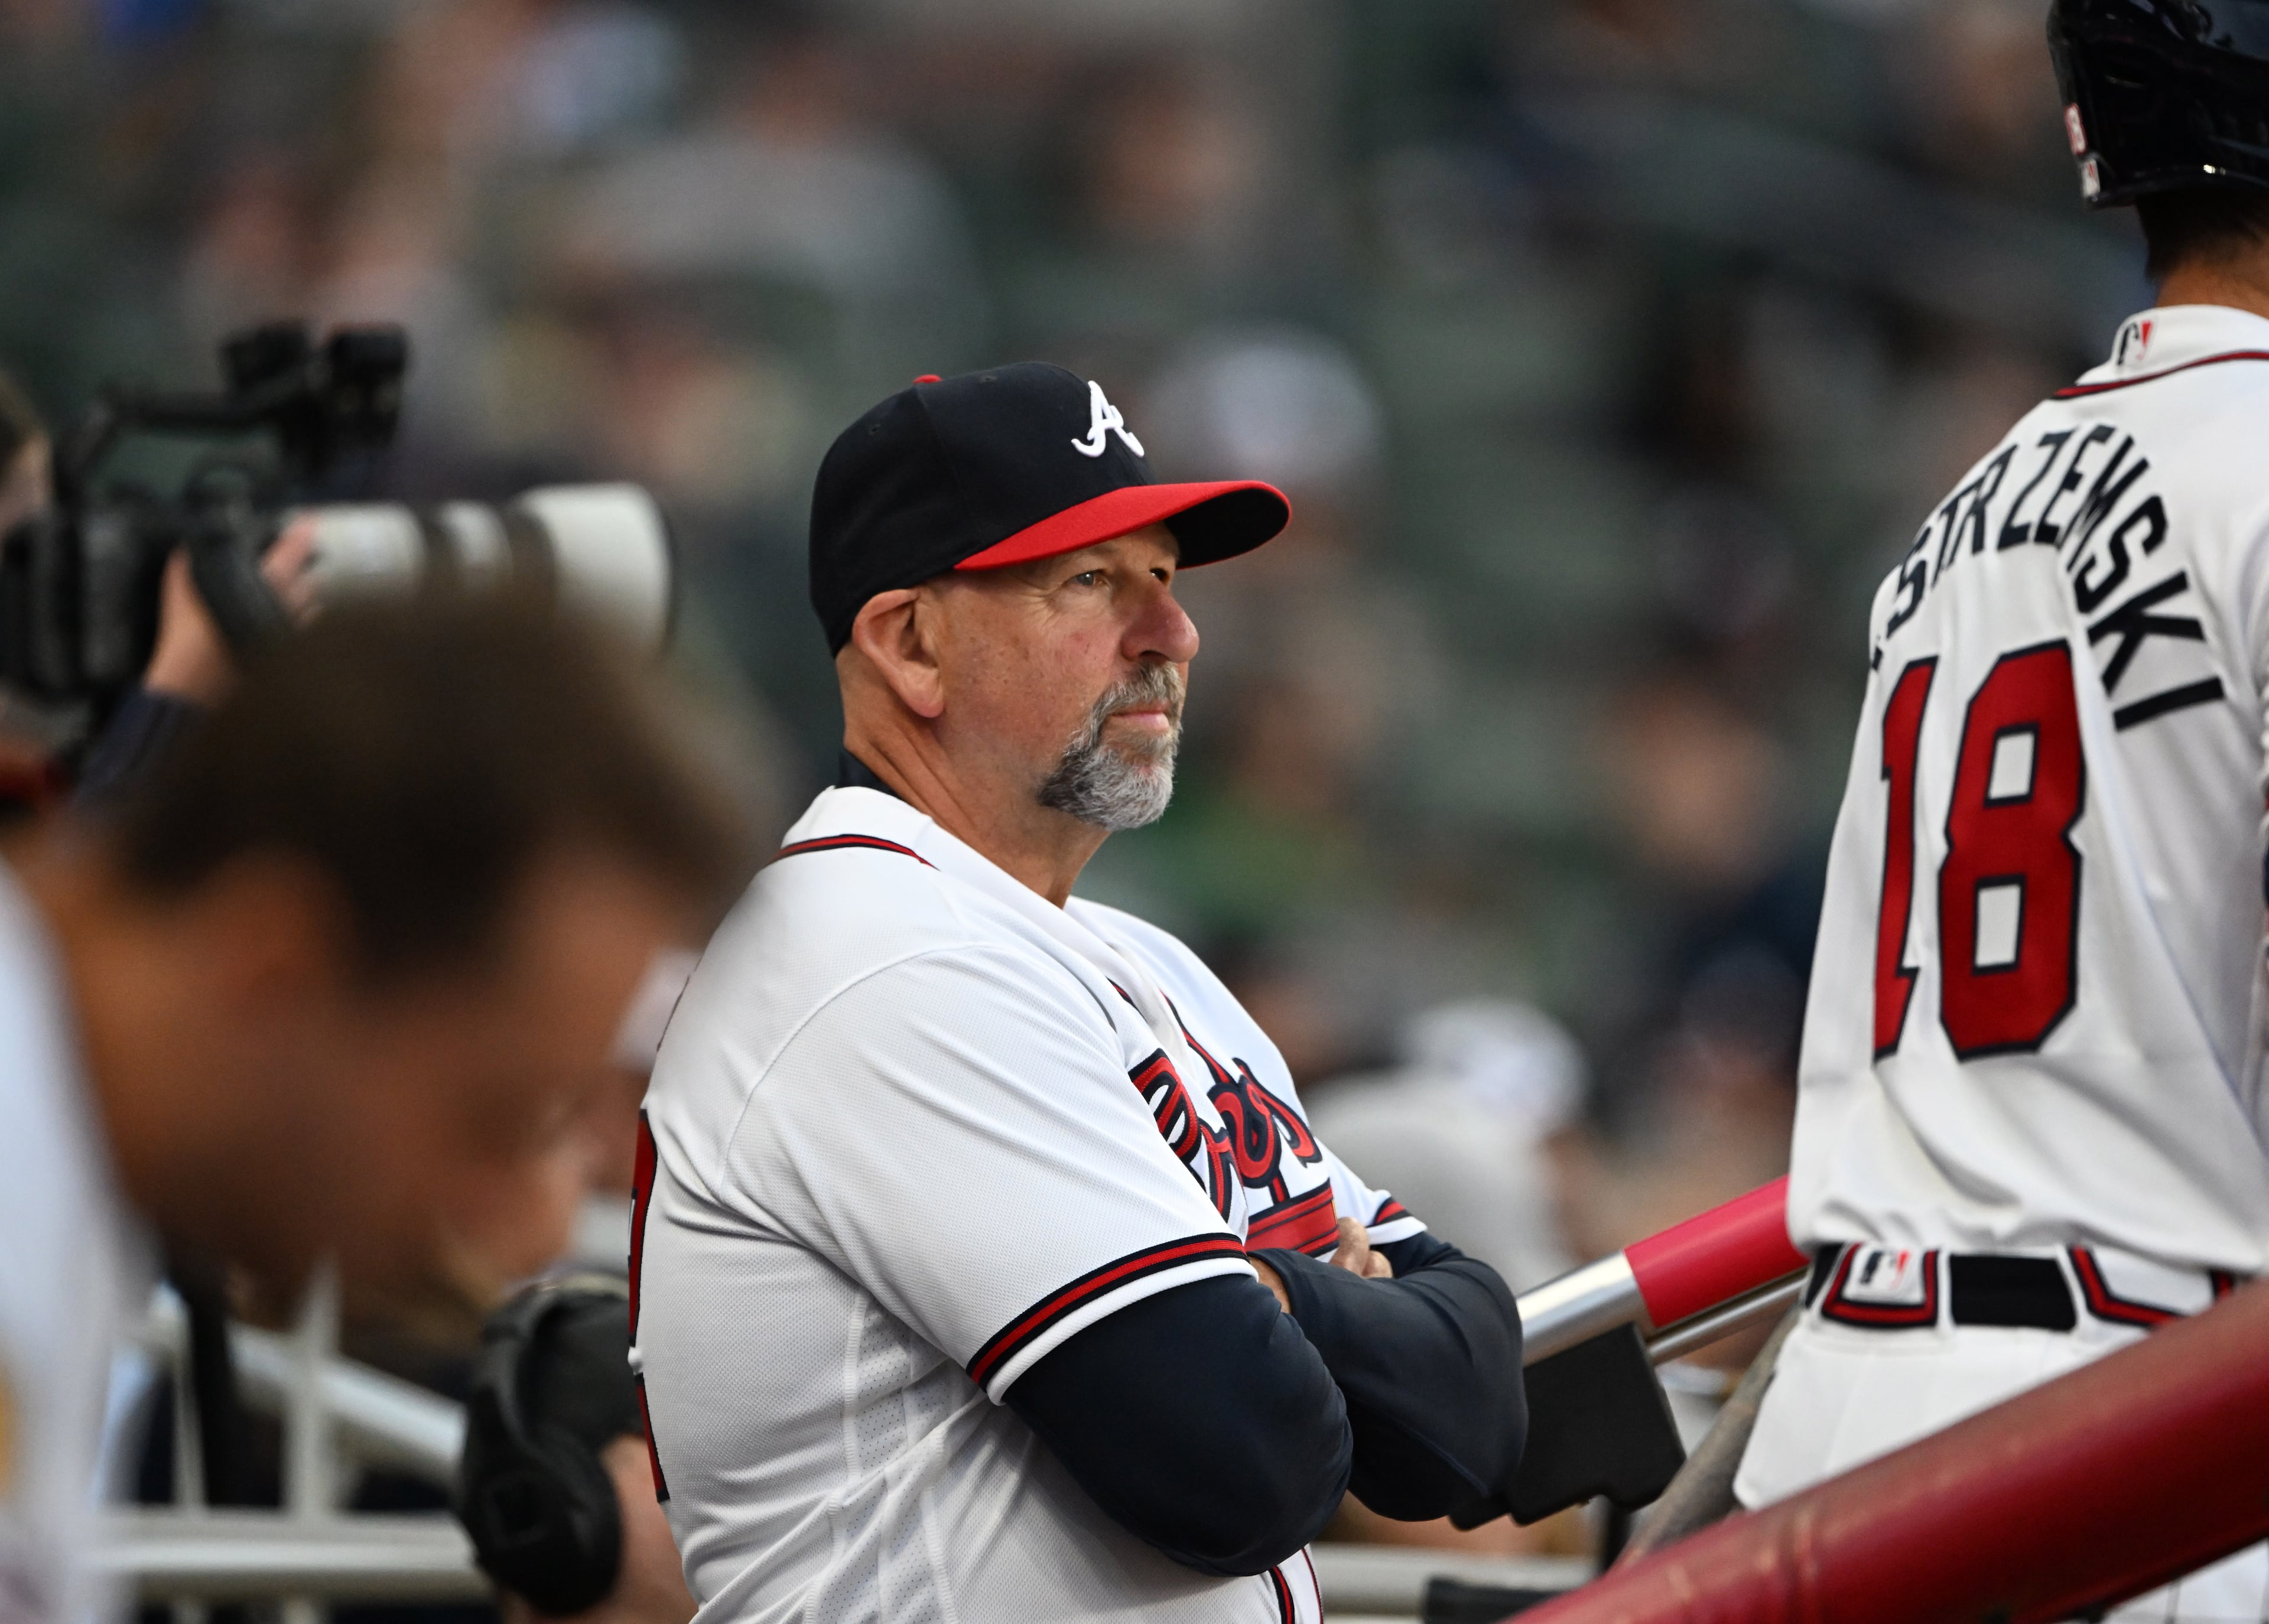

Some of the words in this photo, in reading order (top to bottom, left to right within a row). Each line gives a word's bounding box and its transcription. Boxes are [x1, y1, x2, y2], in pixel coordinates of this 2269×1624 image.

[1071, 380, 1145, 457] A
[1871, 424, 2225, 733] STRZEMSKI
[1871, 637, 2086, 1066] 18
